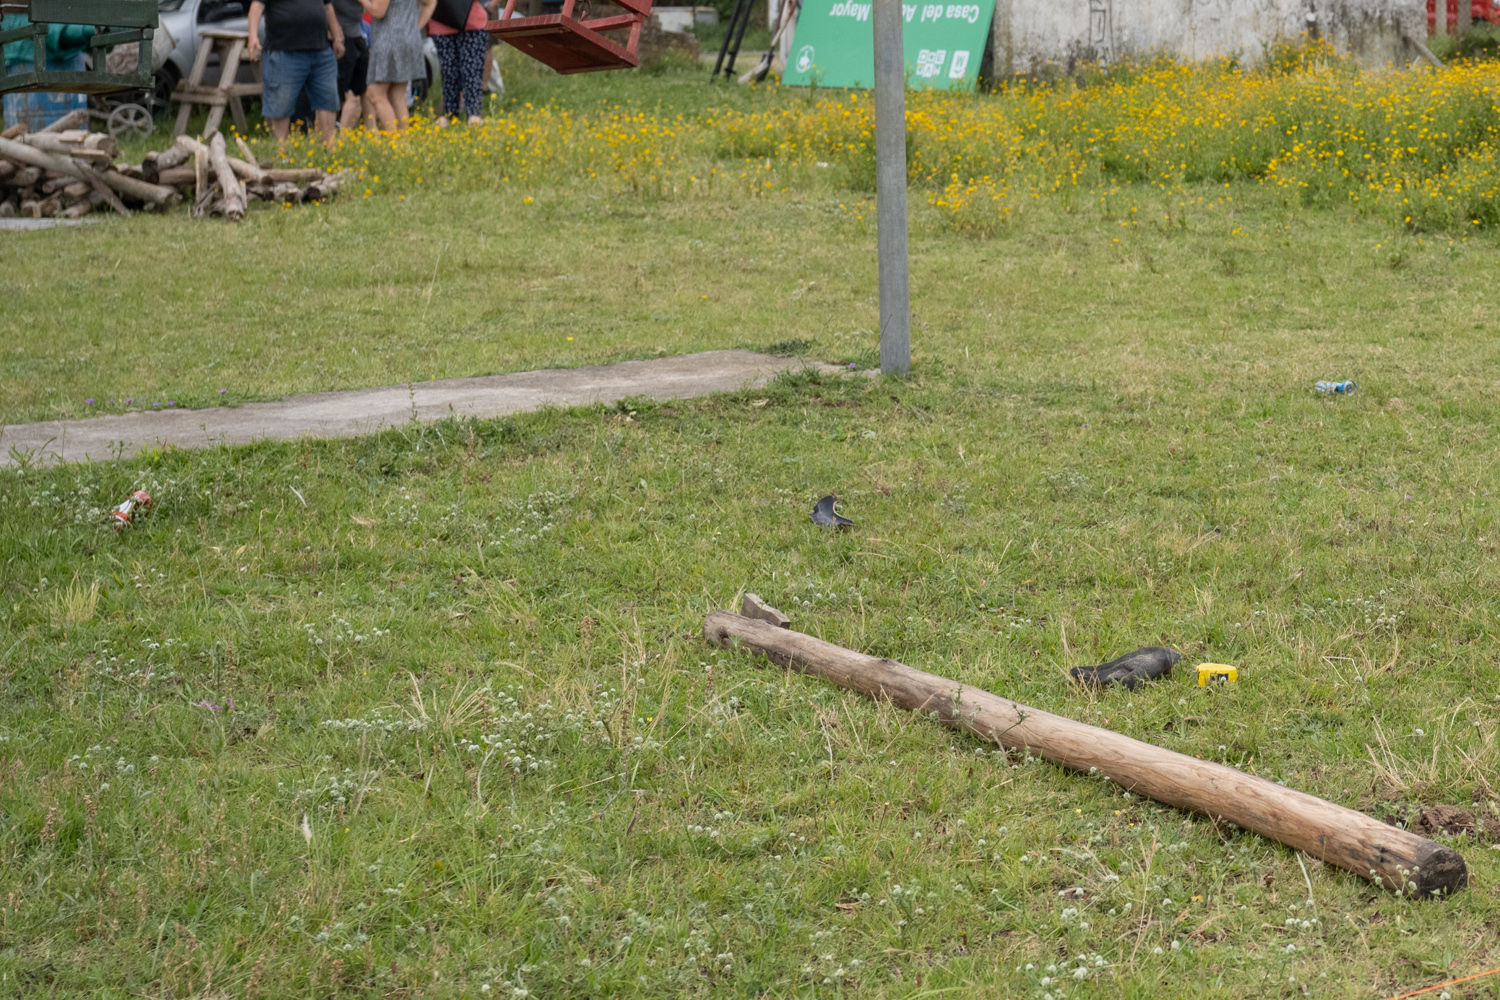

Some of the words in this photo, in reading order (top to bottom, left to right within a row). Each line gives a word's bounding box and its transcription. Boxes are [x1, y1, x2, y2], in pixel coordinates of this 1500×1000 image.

[829, 0, 871, 22] Mayor
[921, 4, 943, 22] del
[946, 4, 980, 24] Casa
